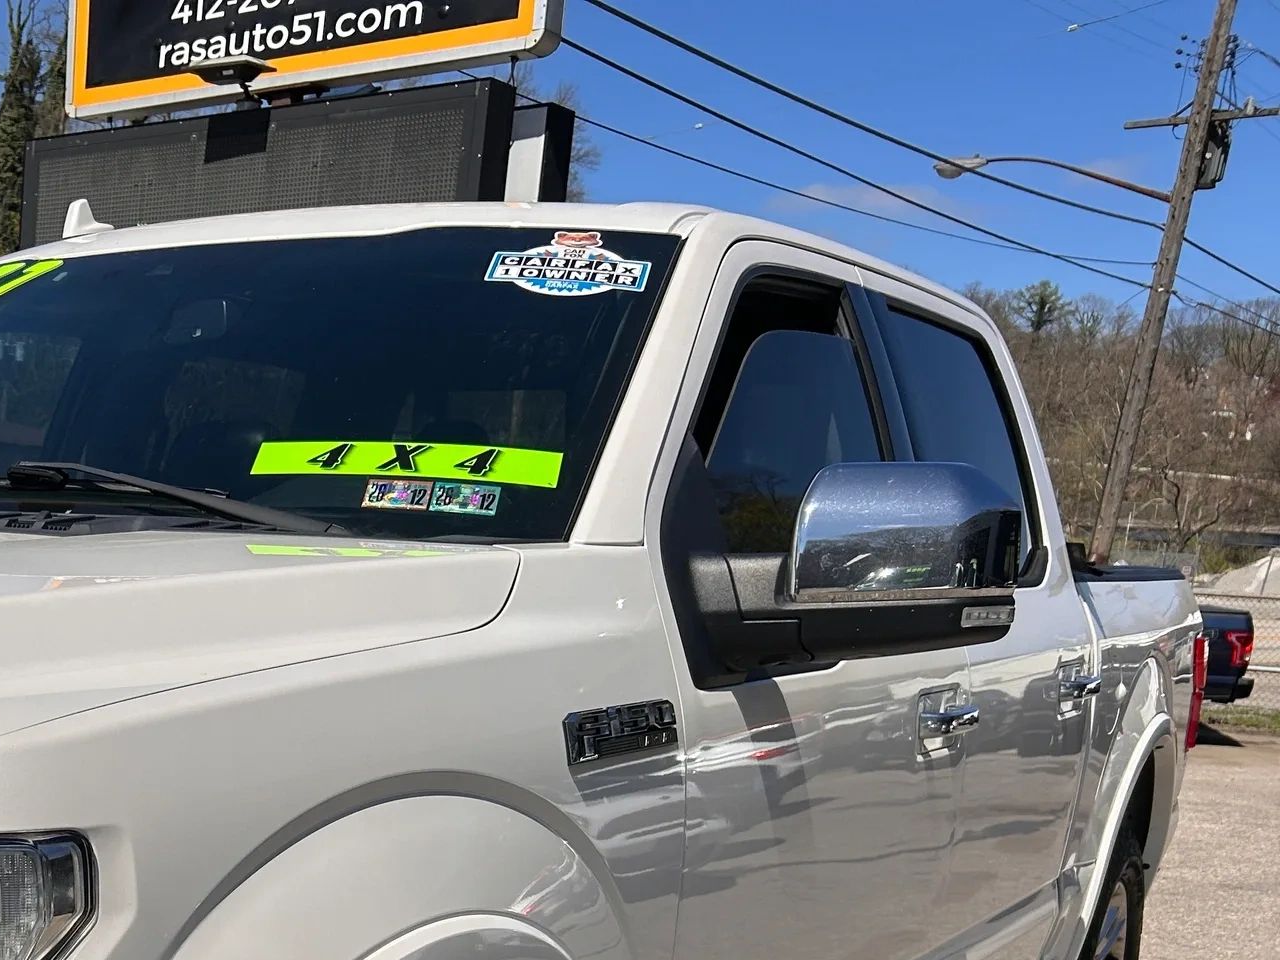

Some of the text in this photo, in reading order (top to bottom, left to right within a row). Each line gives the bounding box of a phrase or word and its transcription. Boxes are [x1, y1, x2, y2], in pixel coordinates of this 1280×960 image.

[158, 0, 423, 68] rasauto51.com
[501, 267, 634, 286] 1 OWNER
[504, 256, 637, 275] CARFAX
[306, 443, 354, 472] 4
[453, 448, 503, 476] 4
[410, 488, 428, 505] 12
[479, 493, 497, 511] 12
